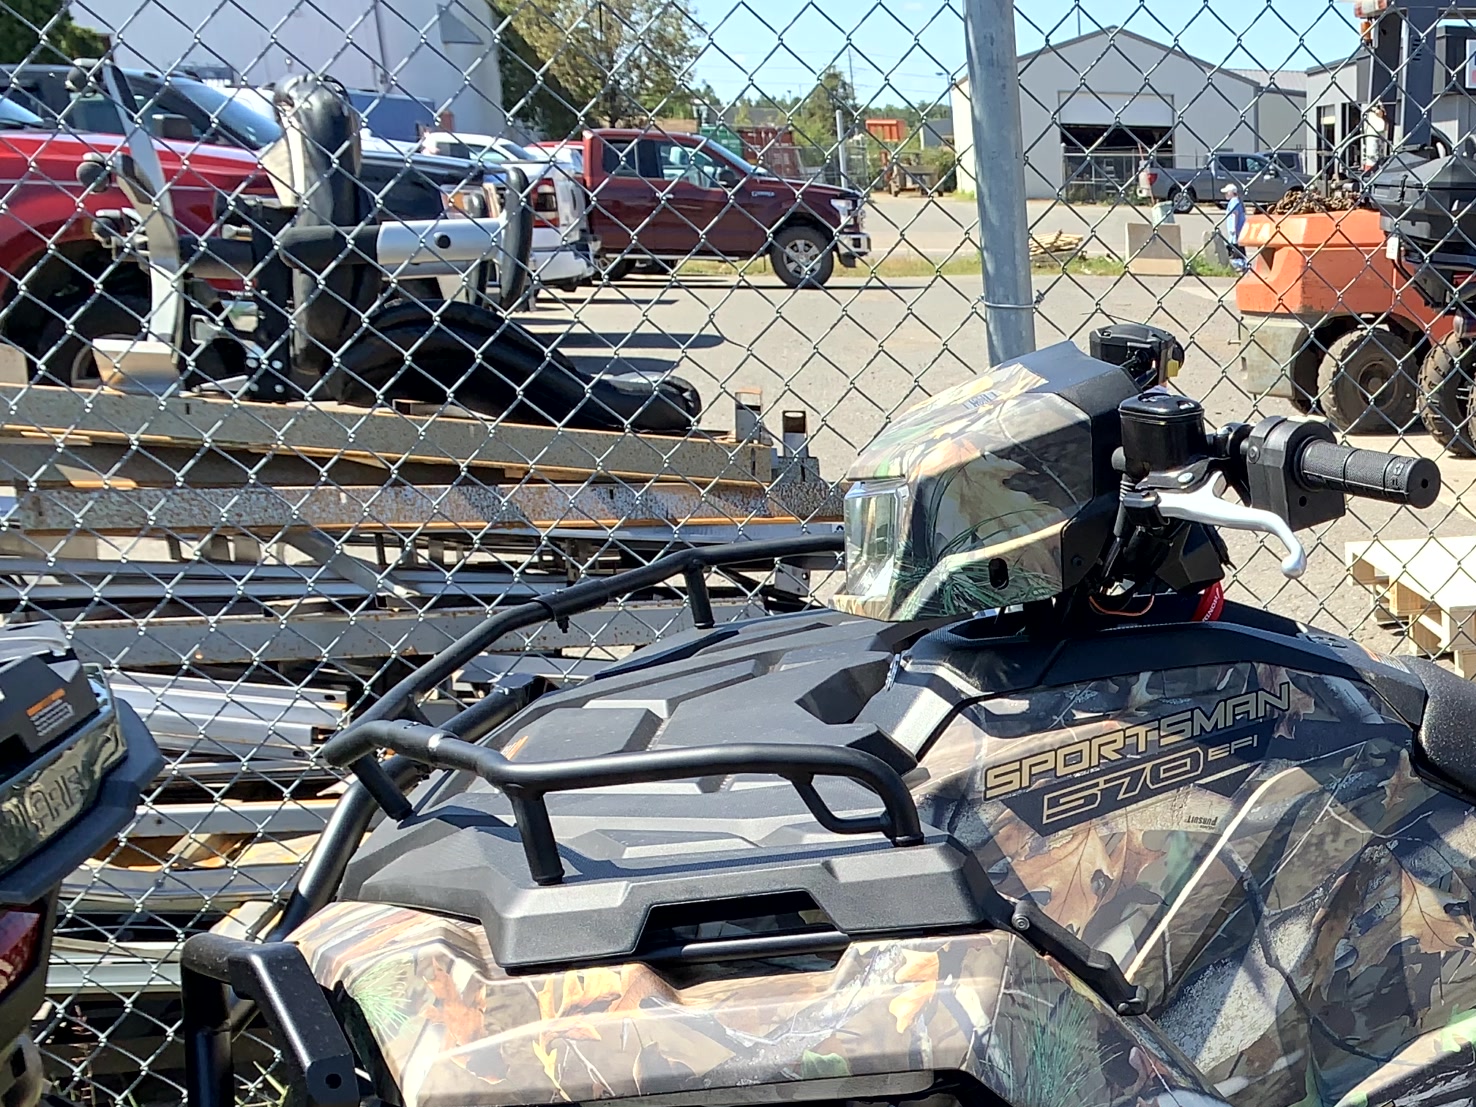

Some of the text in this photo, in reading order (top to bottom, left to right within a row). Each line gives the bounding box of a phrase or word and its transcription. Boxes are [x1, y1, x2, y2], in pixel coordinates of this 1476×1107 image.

[983, 682, 1290, 800] SPORTSMAN
[1042, 734, 1258, 825] 570 EFI
